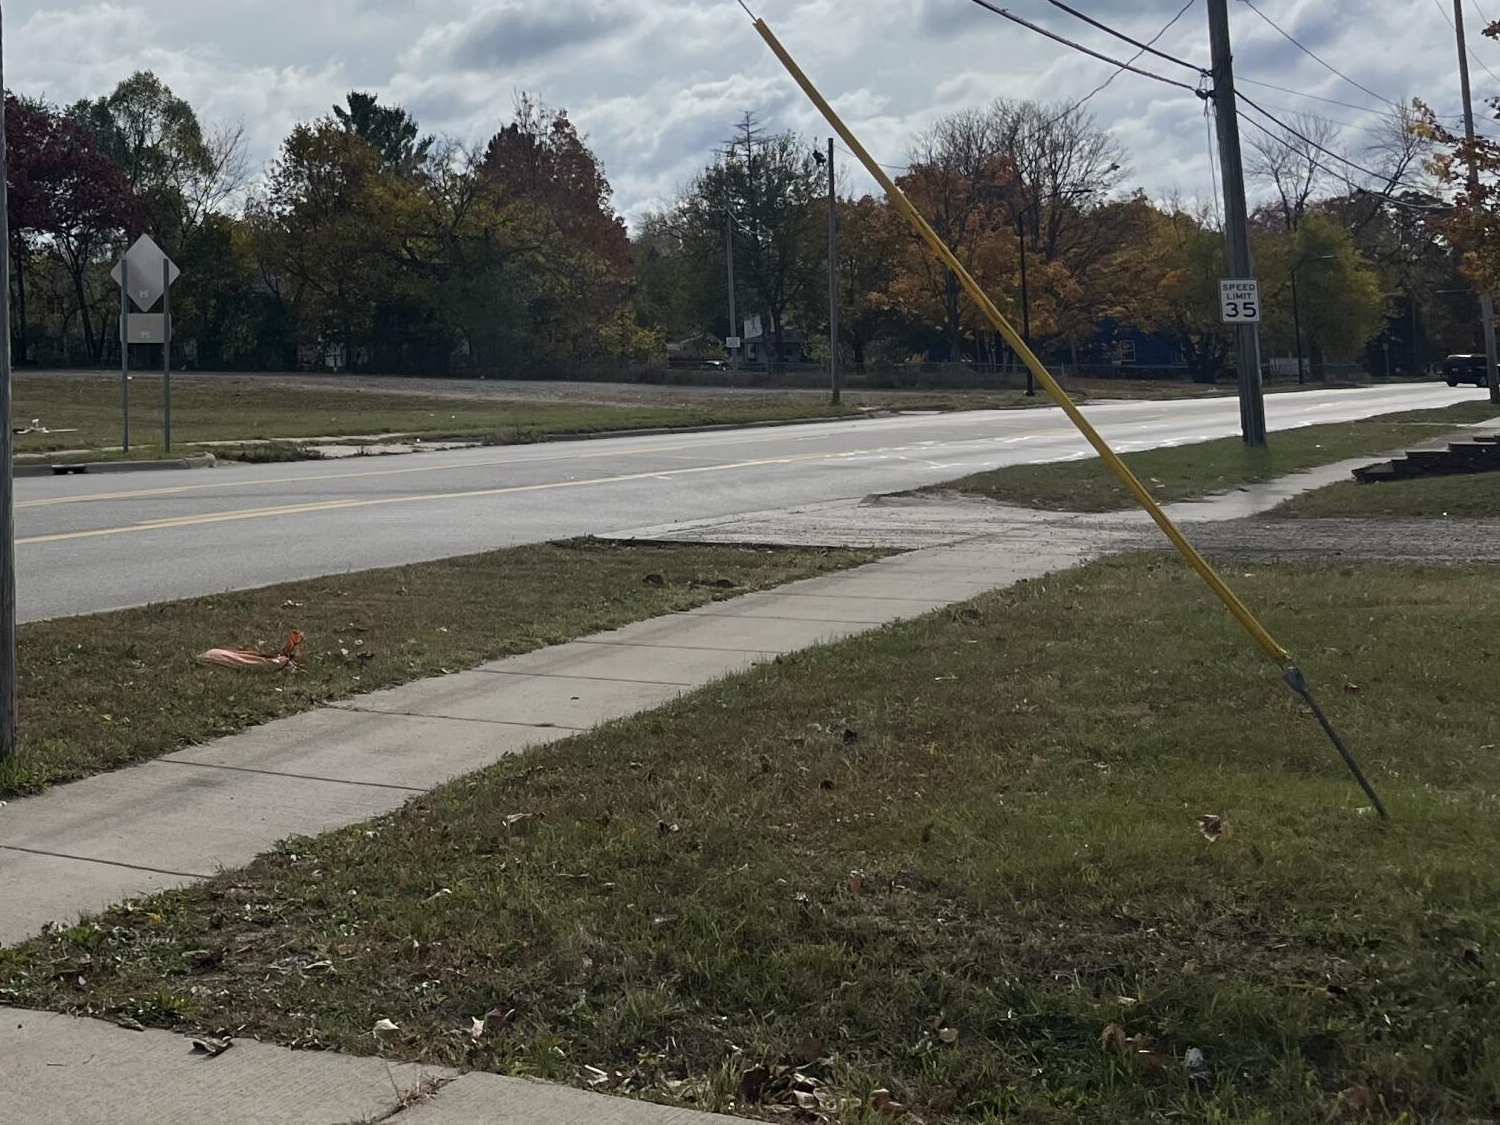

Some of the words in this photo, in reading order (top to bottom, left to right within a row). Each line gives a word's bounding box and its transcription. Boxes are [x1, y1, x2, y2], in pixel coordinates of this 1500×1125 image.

[1222, 283, 1255, 291] SPEED
[1226, 292, 1252, 300] LIMIT
[1225, 302, 1257, 318] 35
